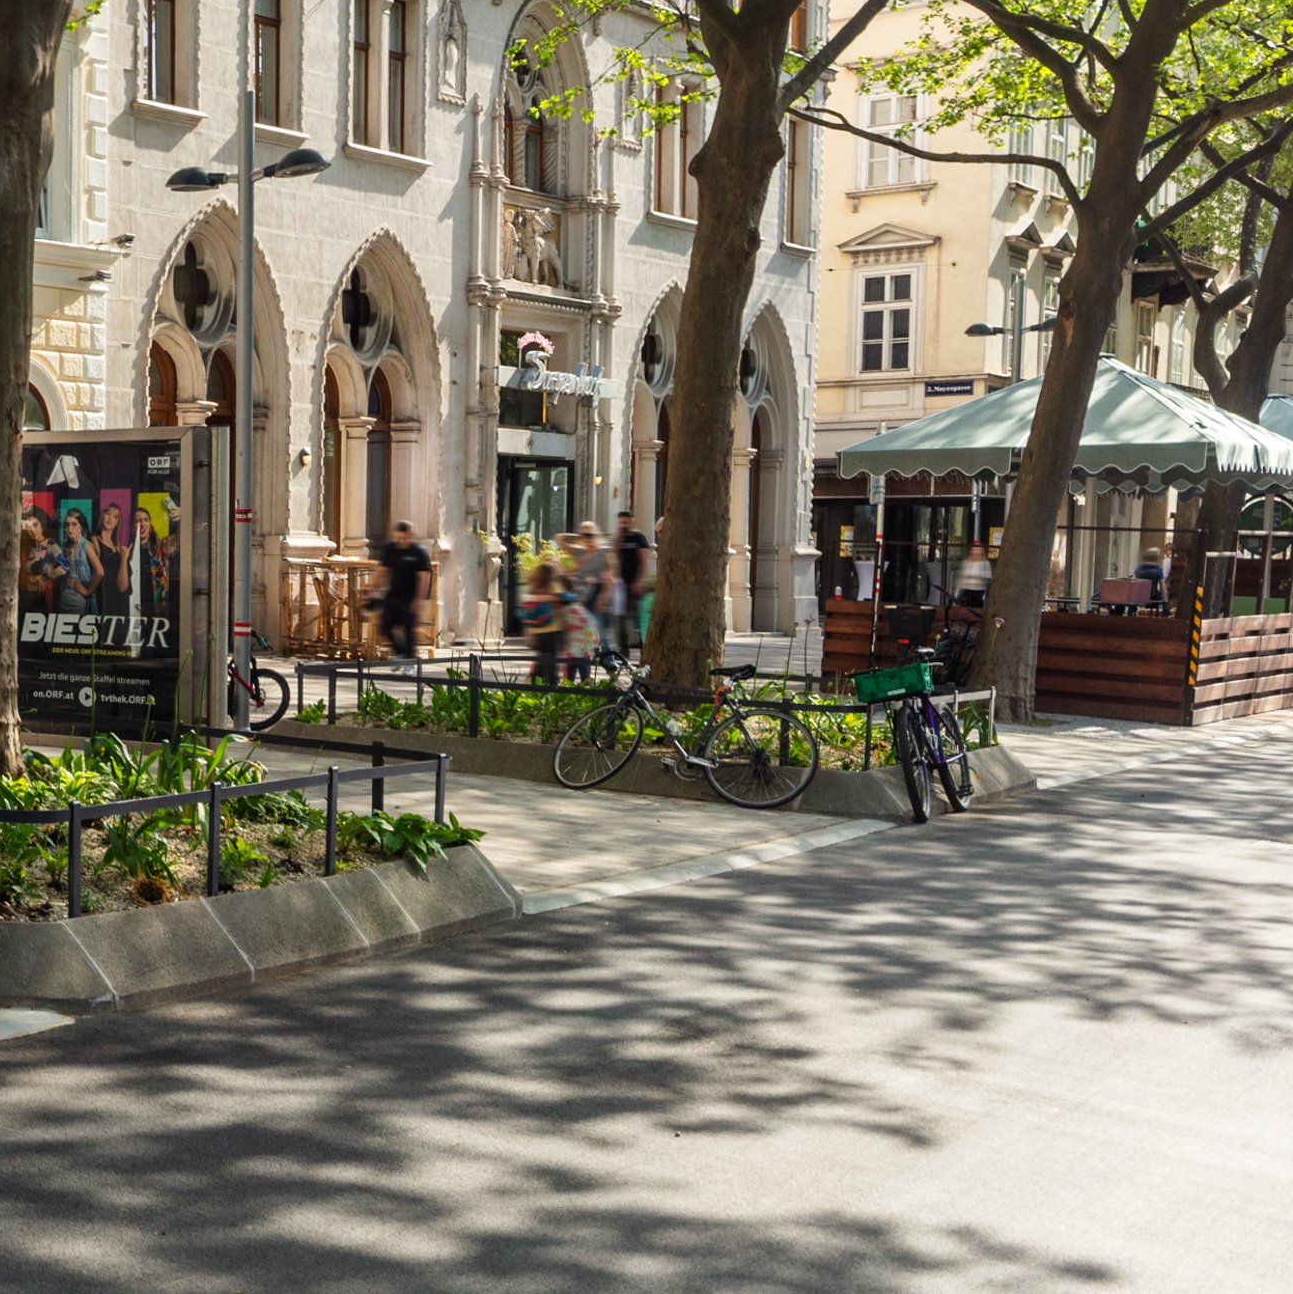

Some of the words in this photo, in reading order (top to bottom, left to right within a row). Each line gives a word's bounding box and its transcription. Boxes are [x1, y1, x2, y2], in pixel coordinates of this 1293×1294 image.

[149, 458, 169, 467] ORF
[20, 612, 171, 648] BIESTER
[39, 671, 56, 680] Jetzt
[58, 673, 69, 681] die
[70, 675, 91, 683] ganze
[93, 674, 116, 683] Staffel
[117, 677, 150, 686] streamen
[33, 689, 74, 700] on.ORF.at
[101, 693, 156, 705] tvthek.ORF.
